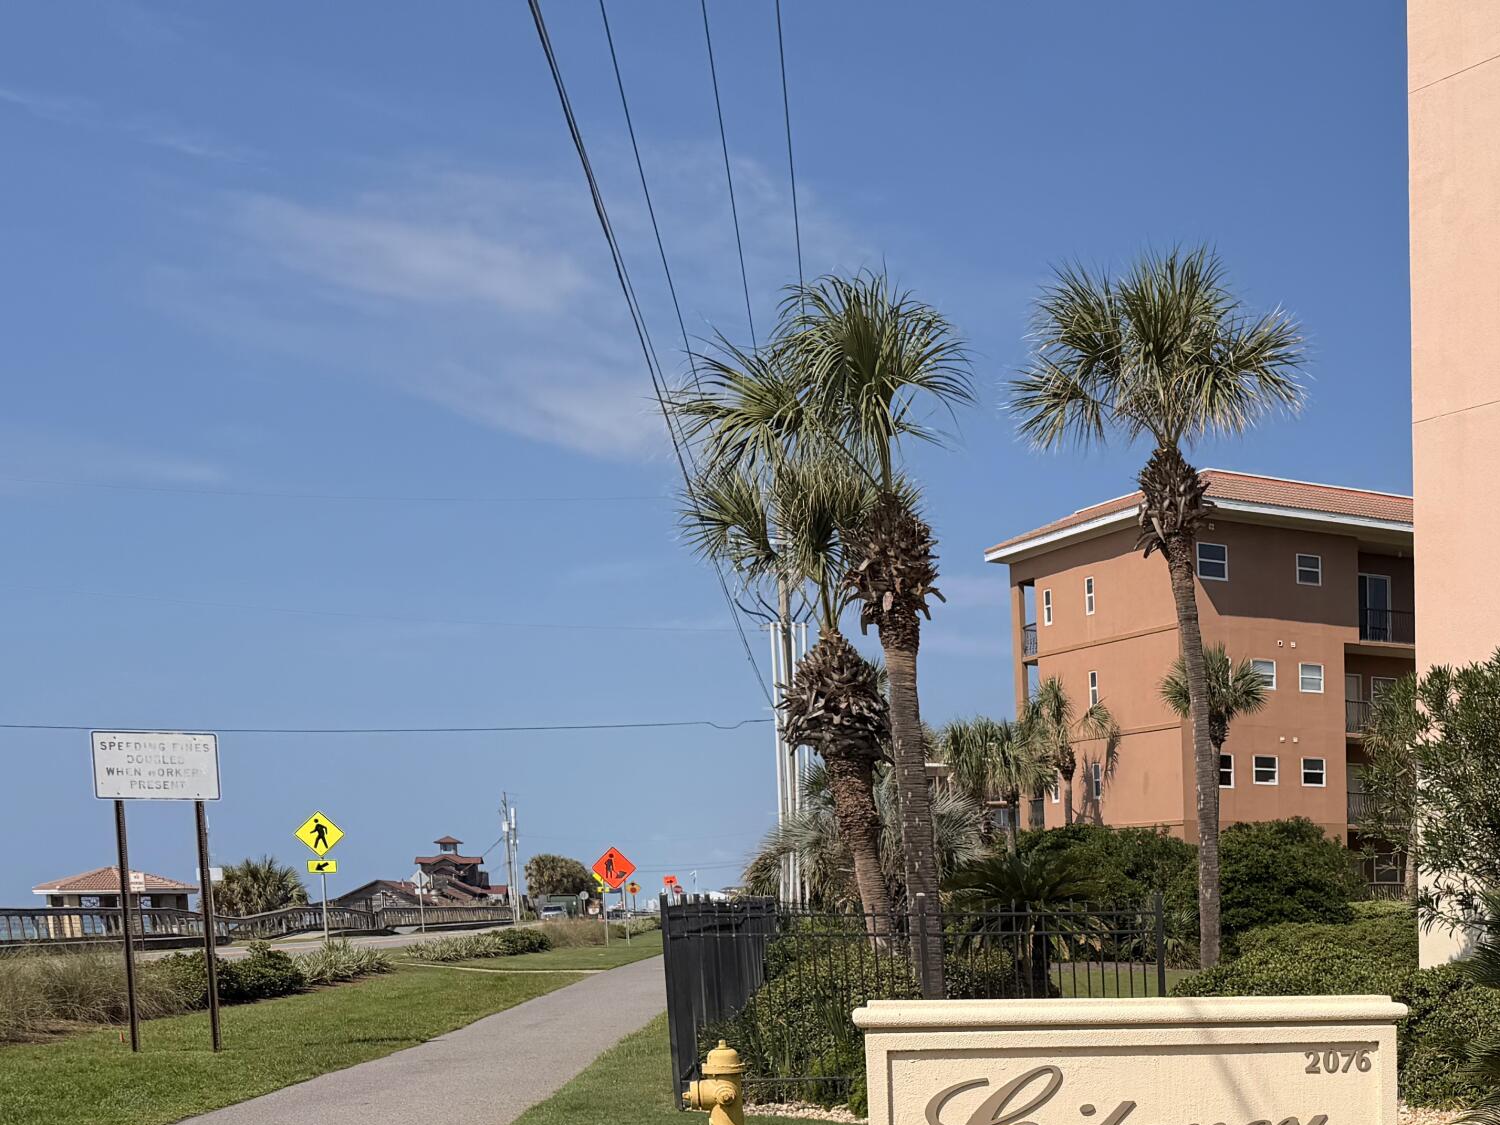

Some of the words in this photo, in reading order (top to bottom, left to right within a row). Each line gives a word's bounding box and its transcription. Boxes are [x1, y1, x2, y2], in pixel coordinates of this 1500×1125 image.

[100, 741, 166, 751] SPEEDING
[105, 767, 142, 777] WHEN
[129, 780, 186, 790] PRESENT
[1304, 1048, 1373, 1075] 2076
